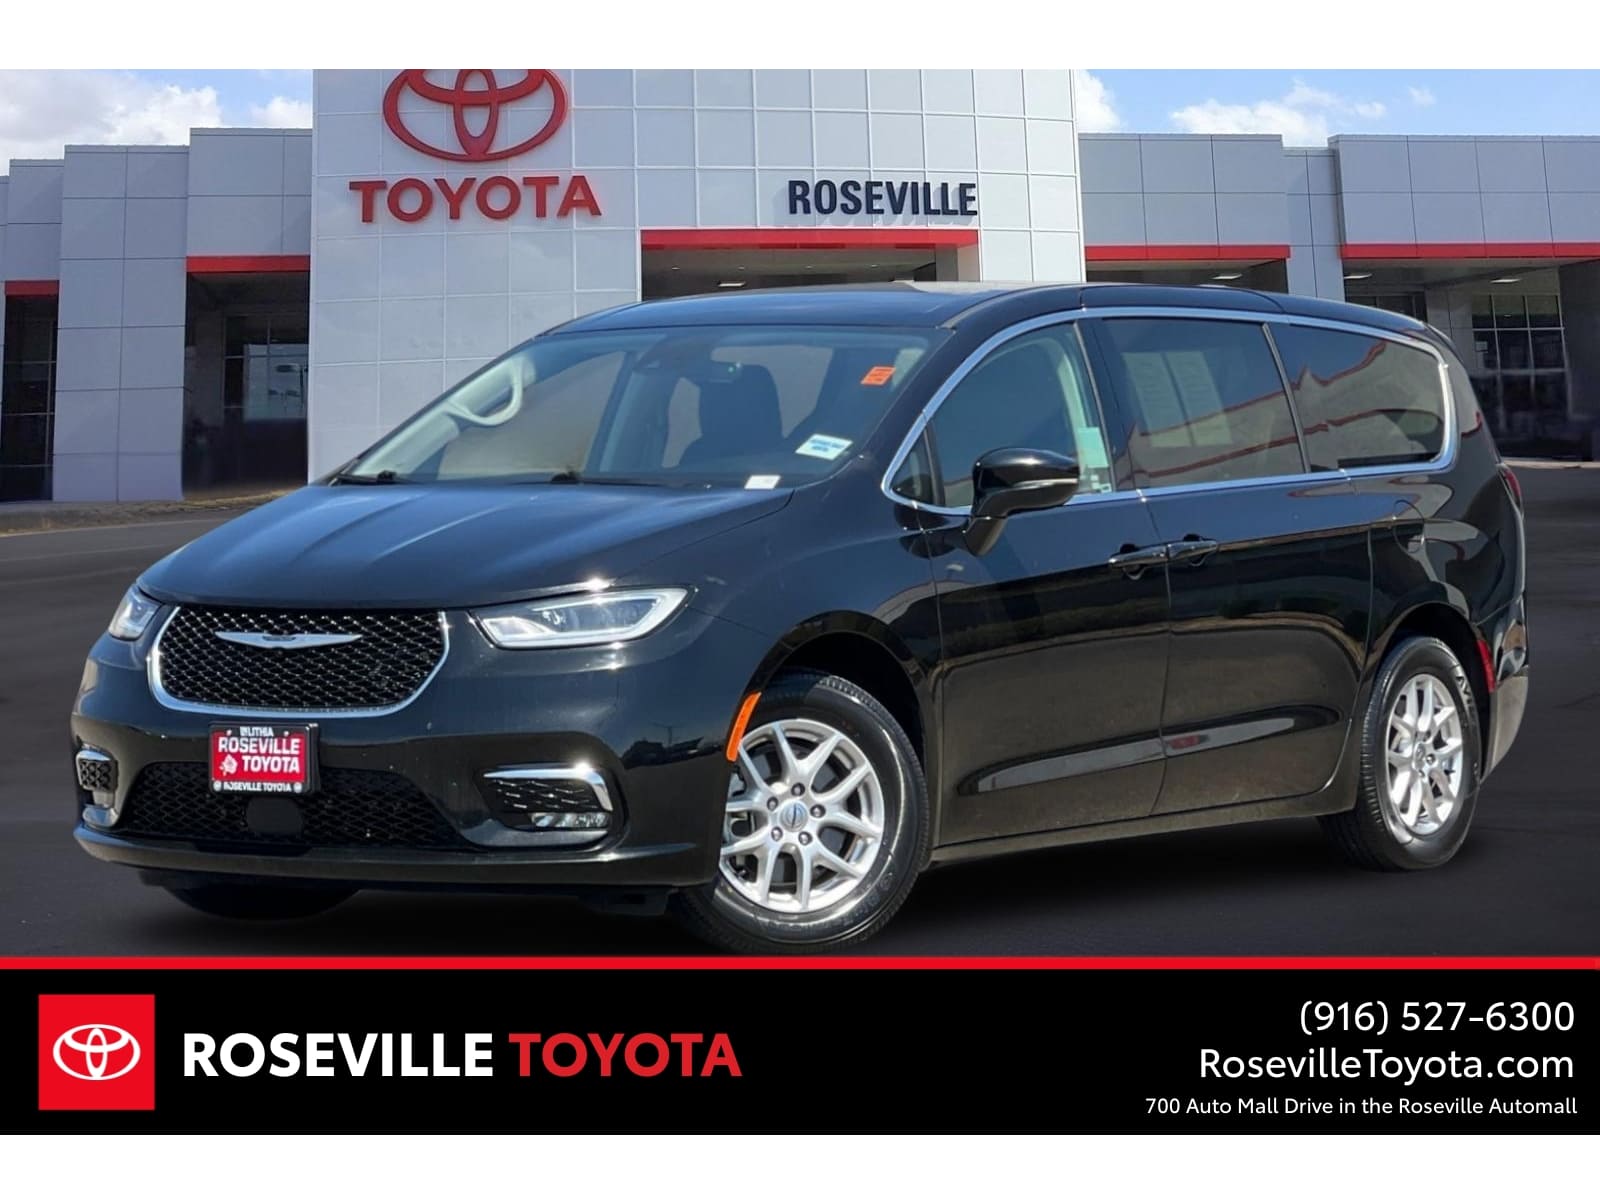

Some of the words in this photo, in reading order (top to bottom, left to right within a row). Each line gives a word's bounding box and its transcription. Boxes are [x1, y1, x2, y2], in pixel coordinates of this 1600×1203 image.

[349, 175, 602, 223] TOYOTA
[788, 180, 978, 215] ROSEVILLE
[248, 727, 274, 737] LITHIA
[218, 737, 301, 755] ROSEVILLE
[242, 755, 300, 773] TOYOTA
[223, 781, 262, 792] ROSEVILLE
[263, 782, 292, 792] TOYOTA
